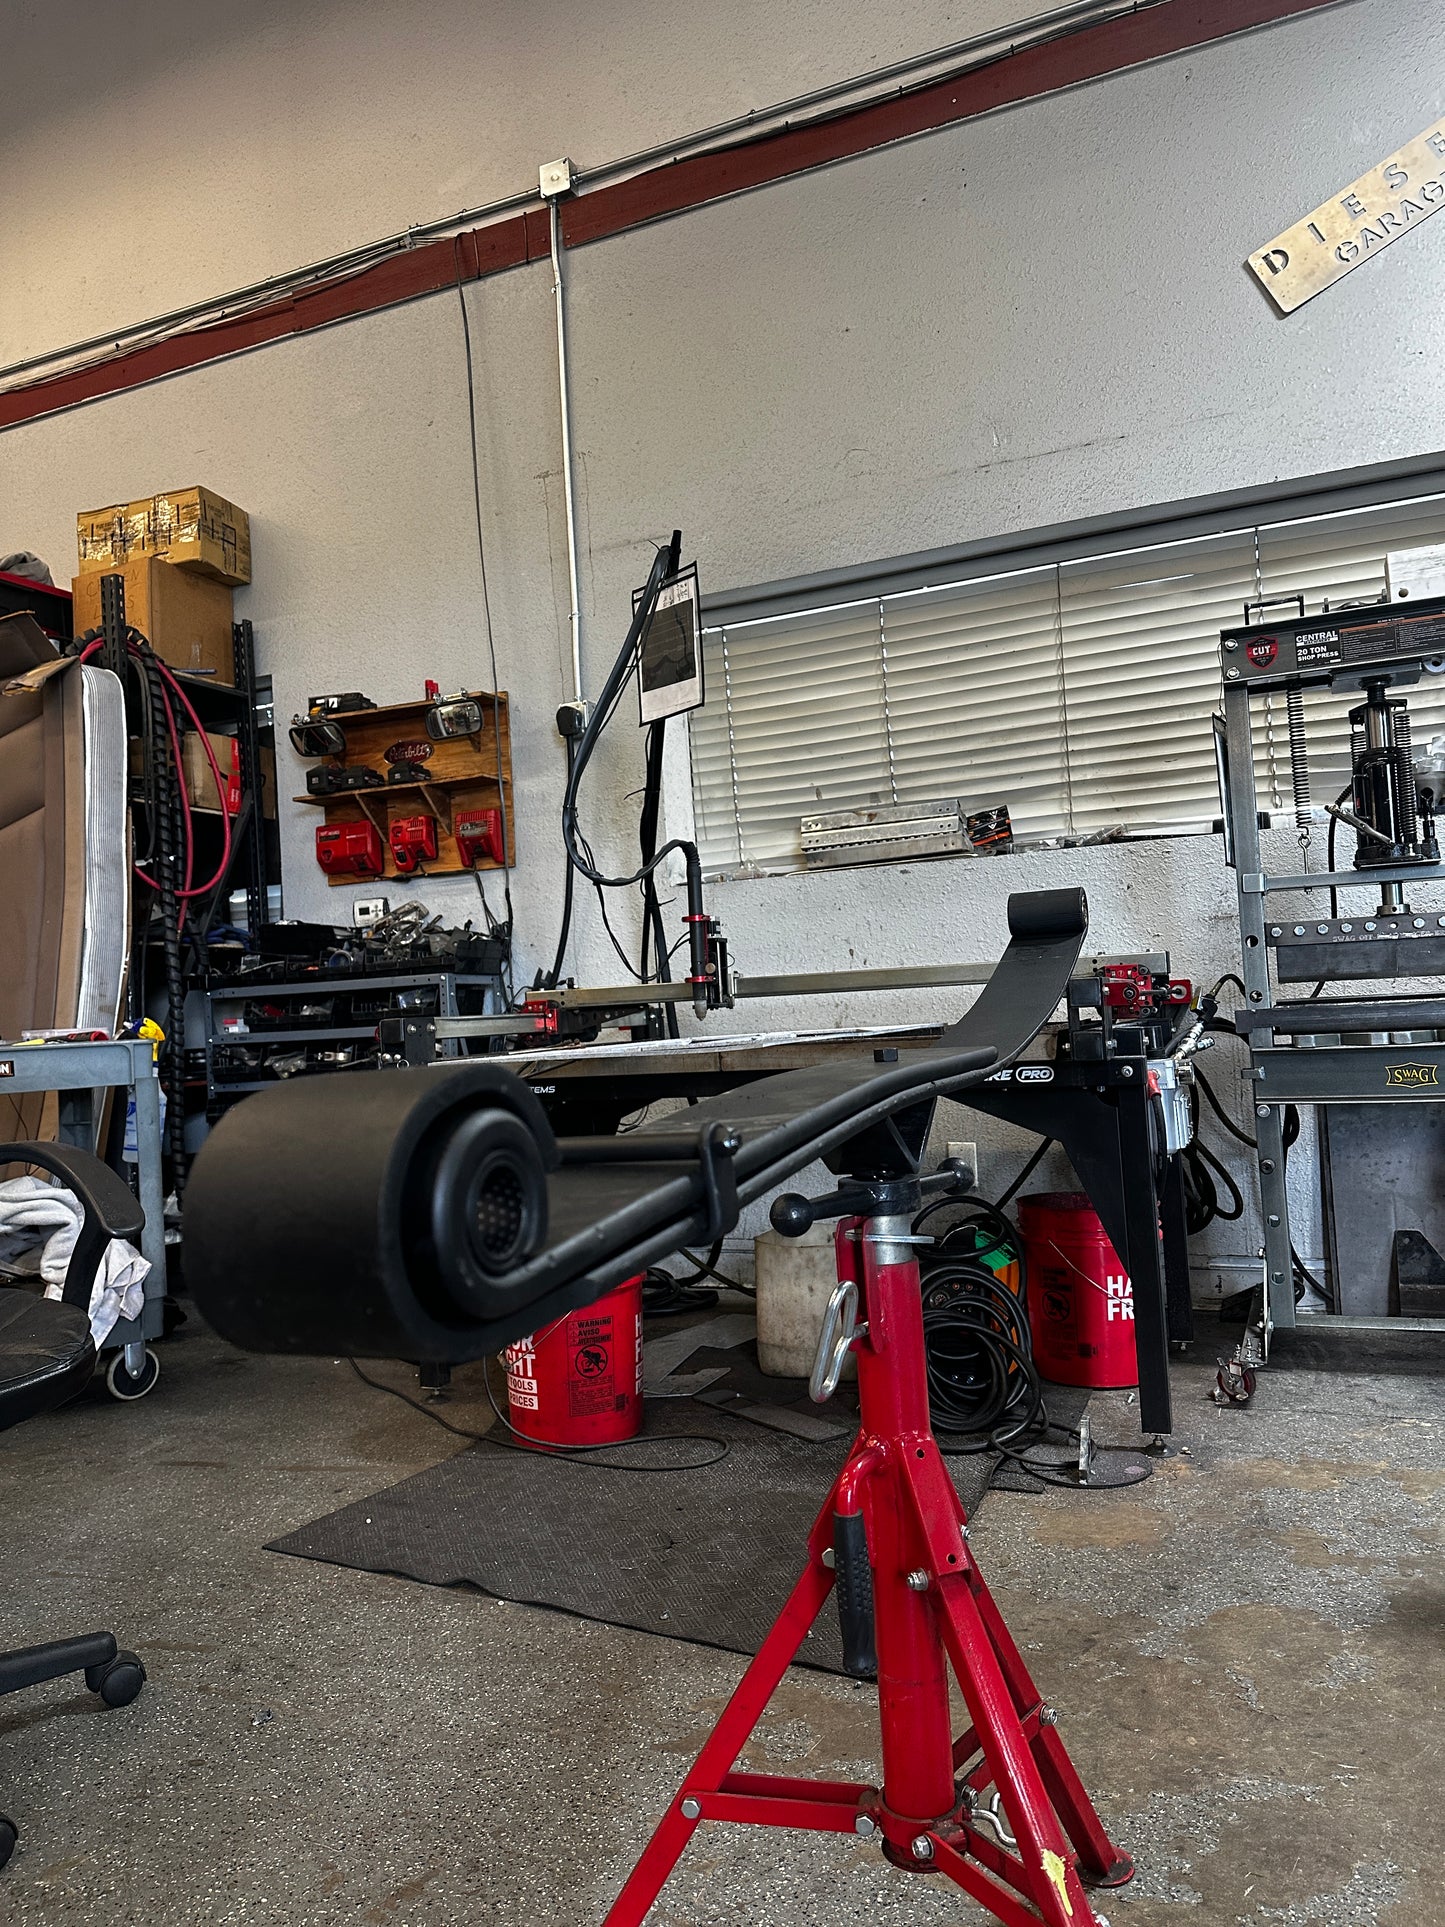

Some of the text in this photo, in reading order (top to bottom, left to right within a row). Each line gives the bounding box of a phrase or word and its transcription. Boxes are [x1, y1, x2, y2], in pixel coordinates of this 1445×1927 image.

[1335, 171, 1445, 263] GARAG
[1296, 630, 1338, 643] CENTRAL
[1252, 645, 1271, 656] CUT
[1297, 645, 1327, 656] 20 TON
[1297, 650, 1339, 662] SHOP PRESS
[1020, 1069, 1051, 1080] PRO
[1394, 1068, 1429, 1083] SWAG
[577, 1317, 612, 1329] WARNING
[577, 1327, 600, 1337] AVISO
[509, 1376, 534, 1391] TOOLS
[509, 1390, 535, 1408] PRICES
